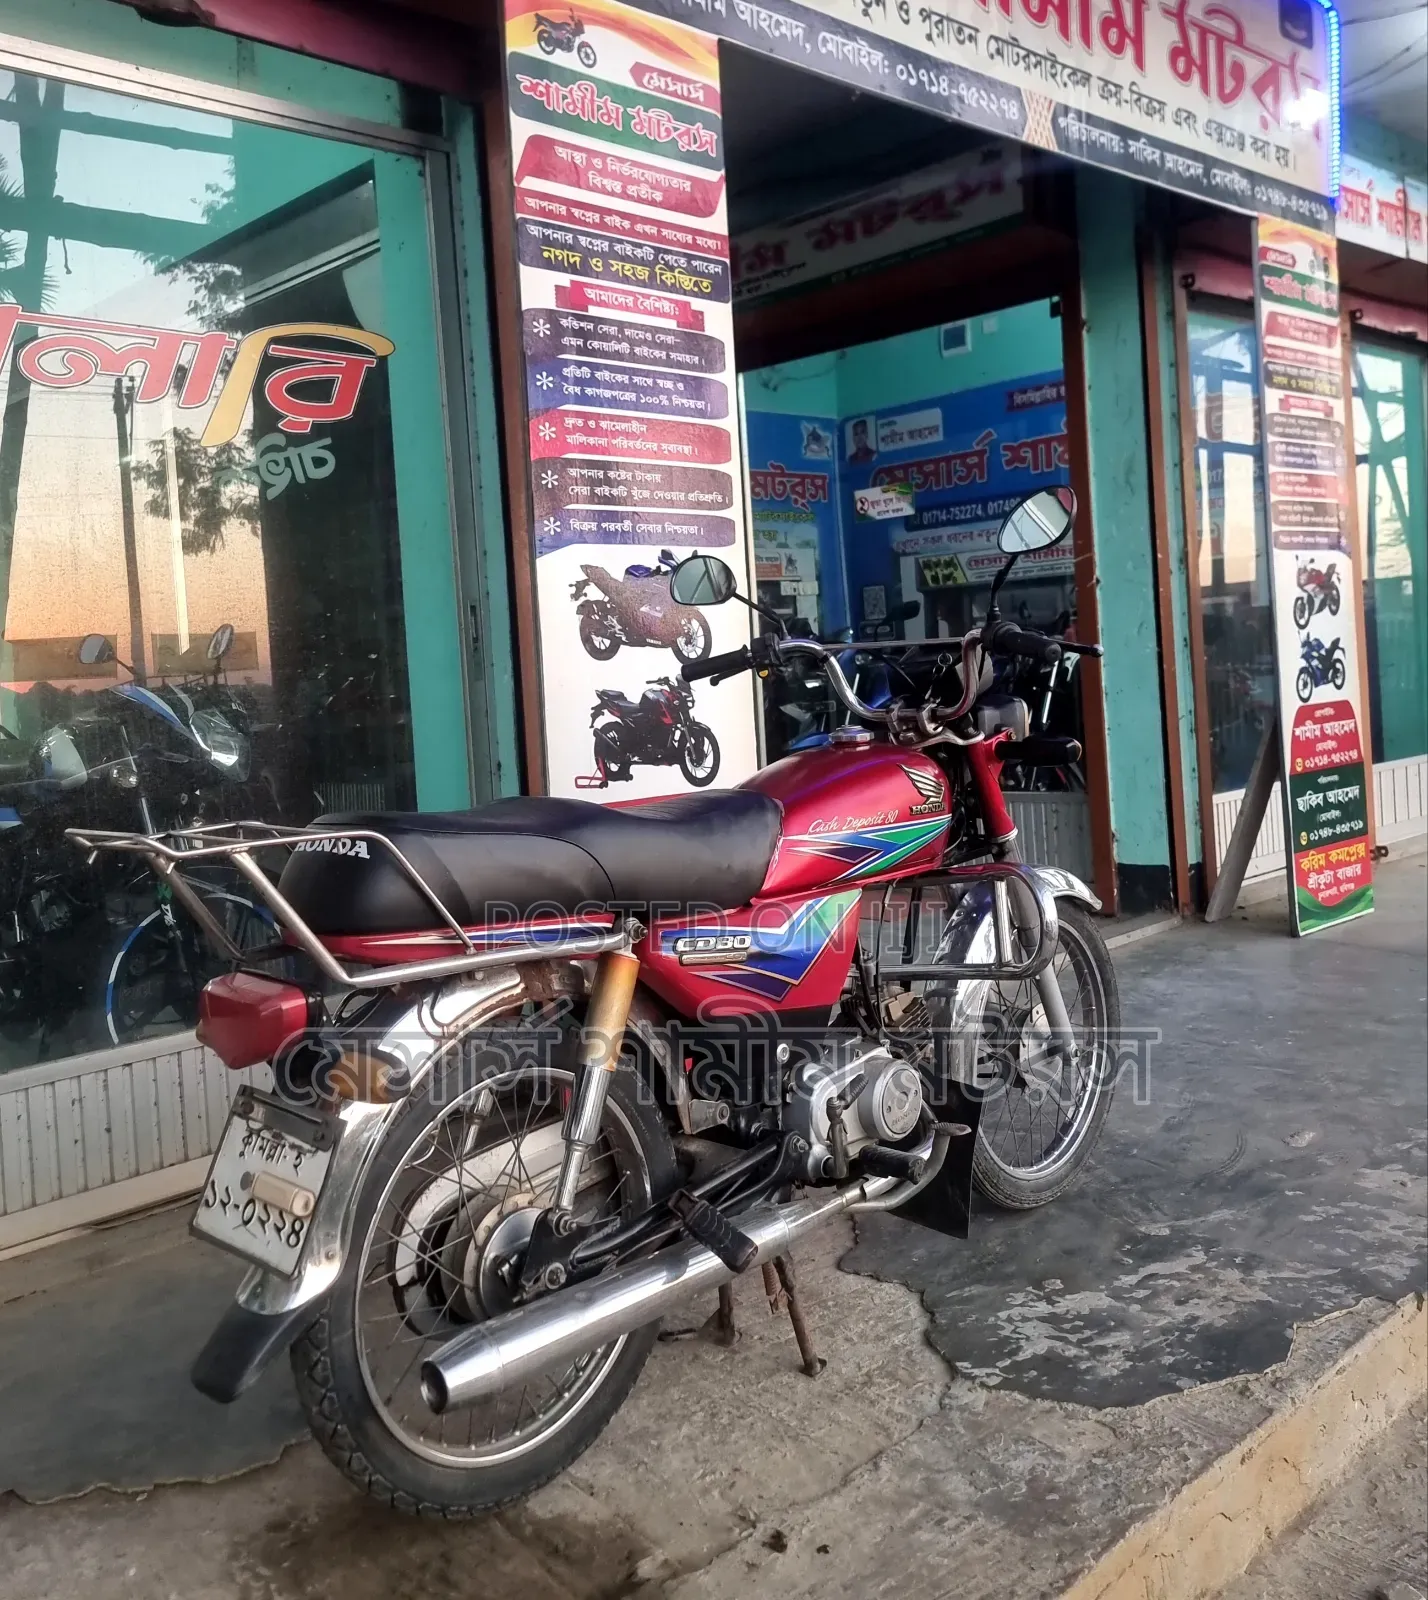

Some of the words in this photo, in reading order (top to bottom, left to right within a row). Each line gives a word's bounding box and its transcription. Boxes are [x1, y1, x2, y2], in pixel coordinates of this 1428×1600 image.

[516, 73, 623, 131] শামীম
[896, 62, 1020, 120] ০১৭১৪-৭৫২২৭৪
[627, 183, 664, 204] প্রতীক
[524, 196, 567, 216] আপনার
[604, 213, 631, 231] বাইক
[526, 224, 573, 246] আপনার
[577, 234, 610, 253] স্বপ্নের
[613, 242, 655, 262] বাইকটি
[658, 252, 687, 269] পেতে
[691, 258, 723, 277] পারেন
[541, 245, 582, 270] নগদ
[588, 257, 604, 272] ও
[608, 259, 650, 284] সহজ
[654, 266, 712, 294] কিস্তিতে
[583, 287, 634, 309] আমাদের
[560, 336, 584, 349] এমন
[562, 364, 592, 380] প্রতিটি
[594, 369, 629, 384] বাইকের
[566, 467, 604, 480] আপনার
[594, 484, 629, 499] বাইকটি
[807, 816, 839, 835] Cash
[842, 811, 886, 832] Deposit
[885, 809, 899, 825] 80
